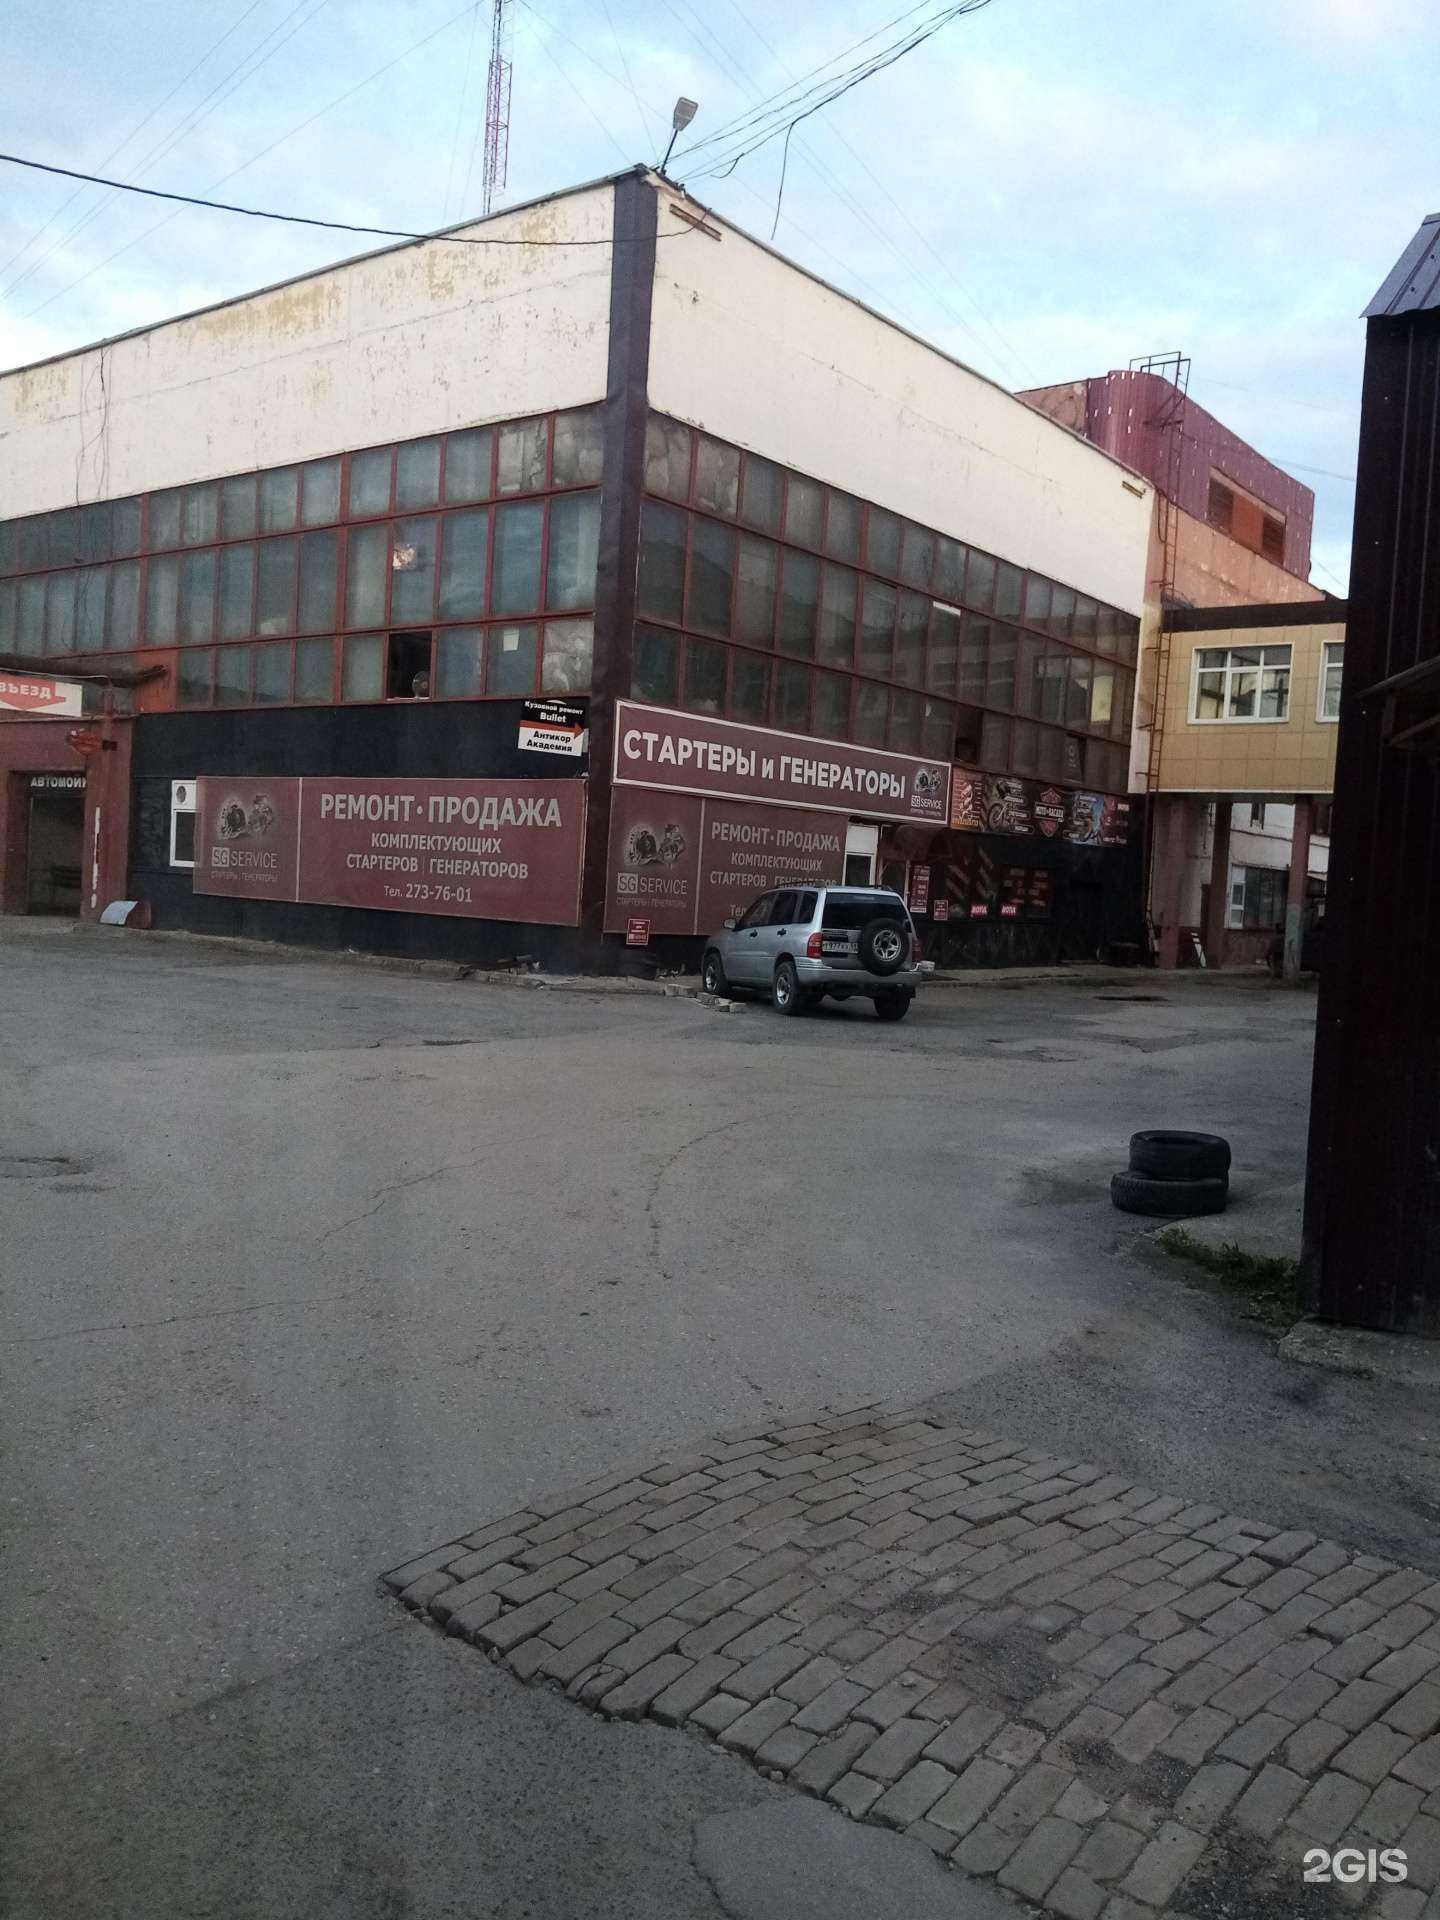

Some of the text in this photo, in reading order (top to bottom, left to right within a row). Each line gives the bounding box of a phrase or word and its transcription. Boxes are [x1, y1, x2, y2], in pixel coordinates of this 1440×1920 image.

[0, 682, 52, 699] ВЪЕЗД
[525, 701, 583, 715] Кузовной ремонт
[540, 712, 567, 723] Bullet
[527, 740, 573, 752] Академия
[533, 731, 571, 744] Антикор
[623, 729, 906, 799] СТАРТЕРЫ и ГЕНЕРАТОРЫ
[321, 794, 562, 831] РЕМОНТ ПРОДАЖА
[371, 833, 502, 854] КОМПЛЕКТУЮЩИХ
[711, 822, 841, 852] РЕМОНТ ПРОДАЖА
[212, 847, 278, 868] SG SERVICE
[347, 854, 529, 879] СТАРТЕРОВ ГЕНЕРАТОРОВ
[731, 852, 823, 873] КОМПЛЕКТУЮЩИХ
[617, 873, 688, 895] SG SERVICE
[710, 871, 767, 888] СТАРТЕРОВ
[384, 884, 472, 902] Тел. 273-76-01
